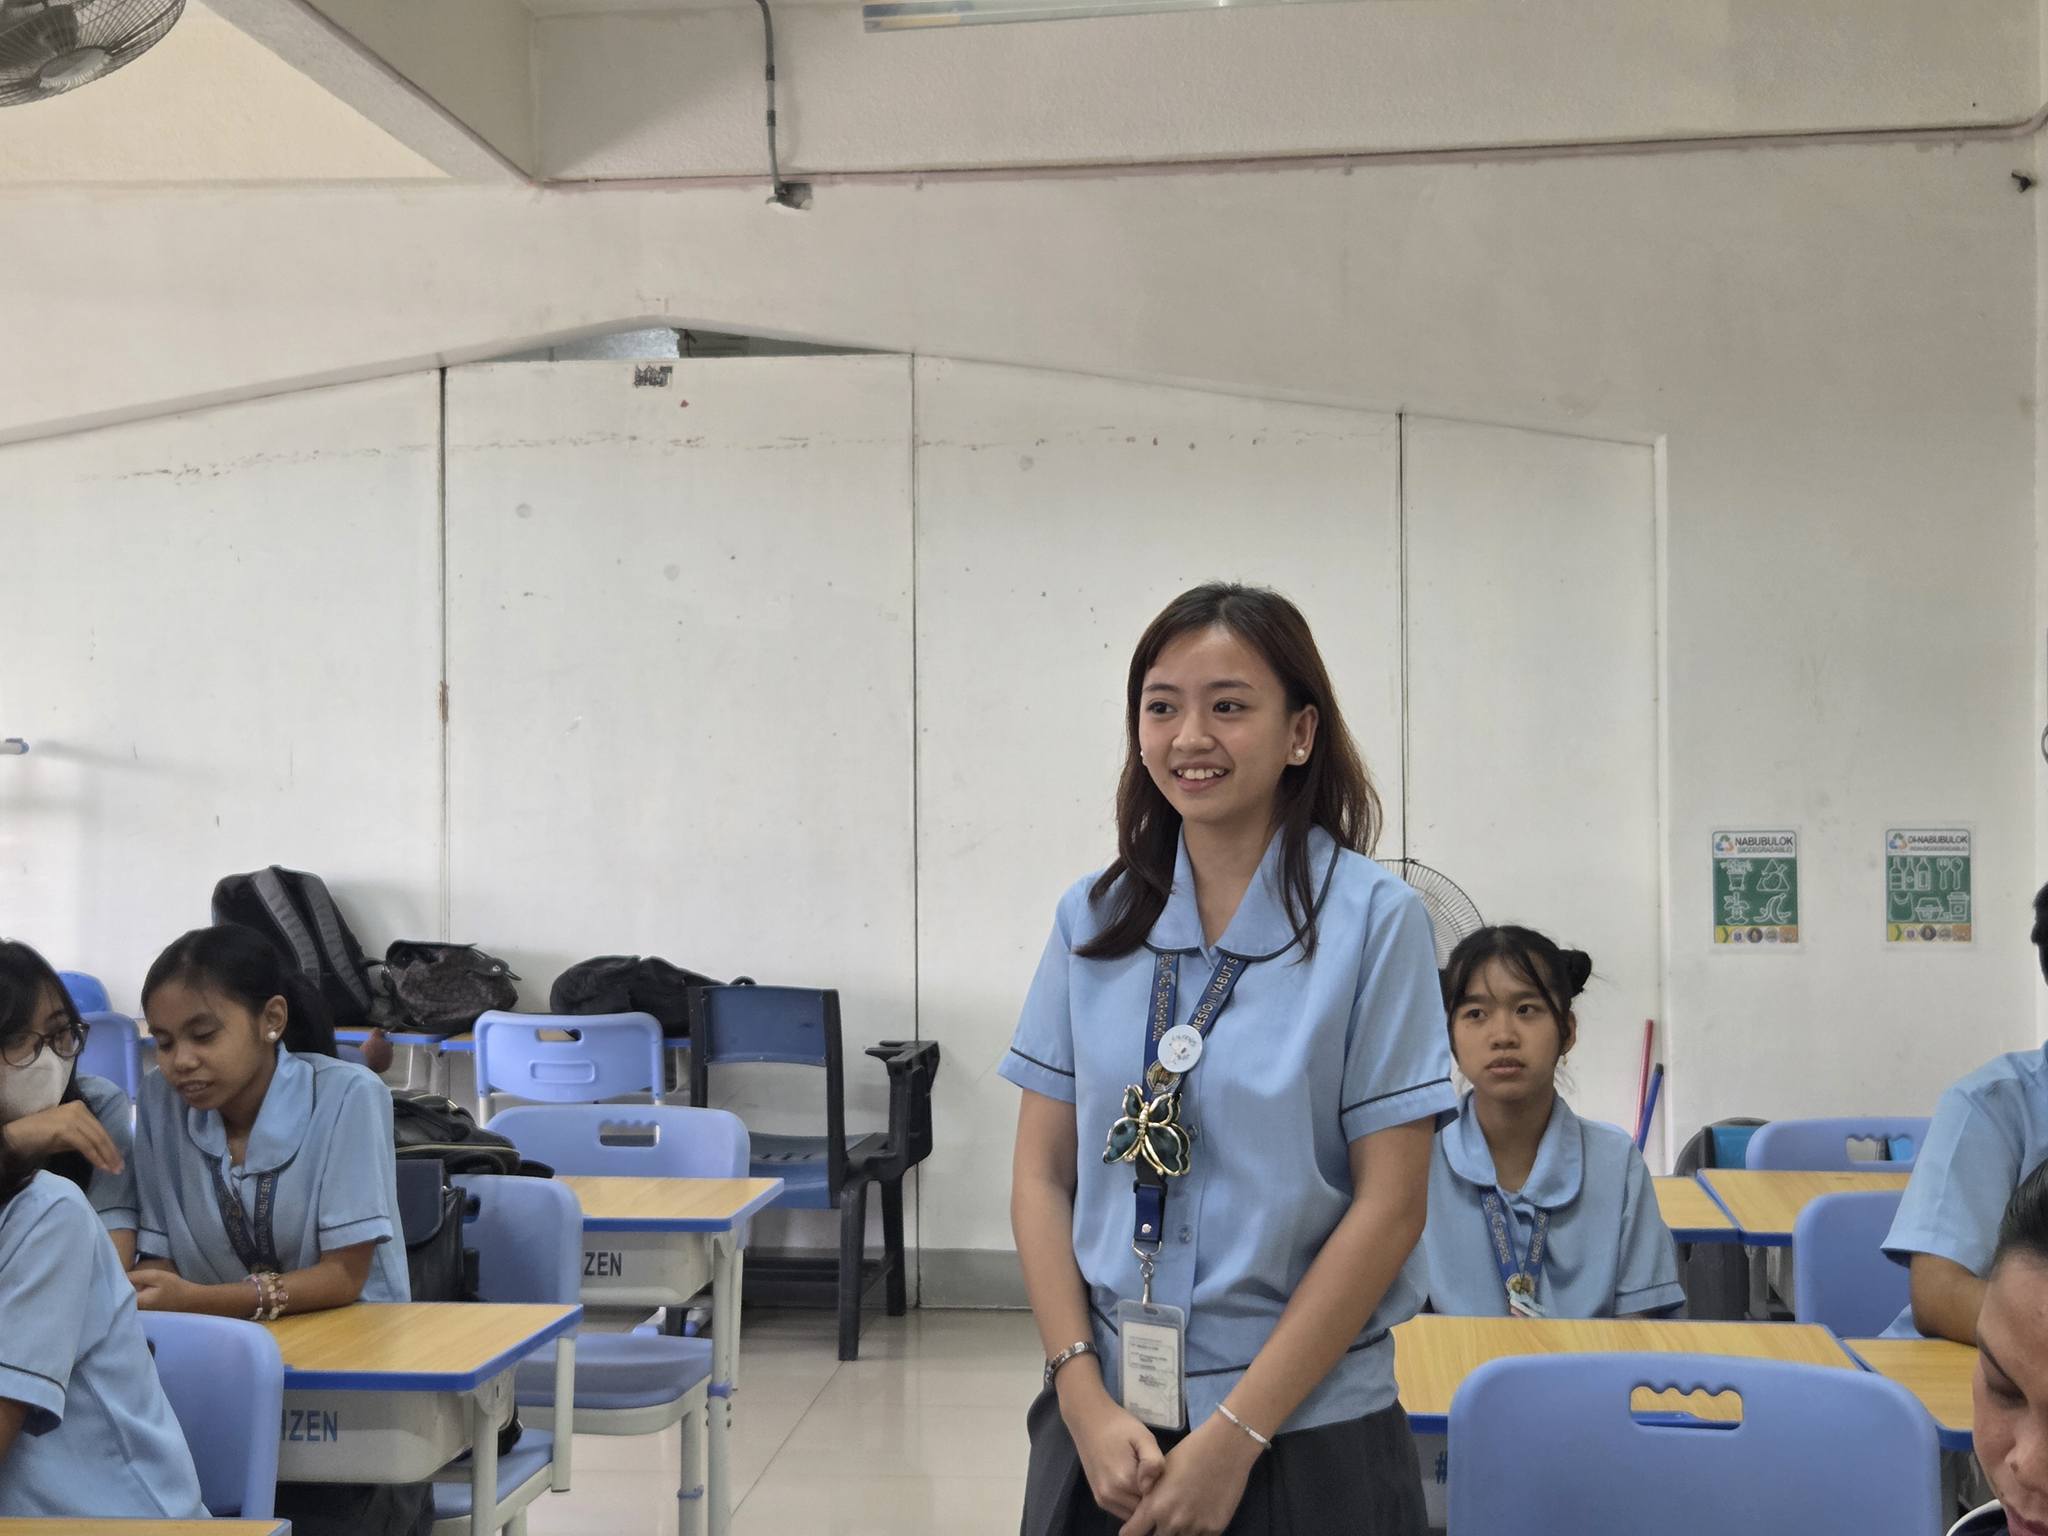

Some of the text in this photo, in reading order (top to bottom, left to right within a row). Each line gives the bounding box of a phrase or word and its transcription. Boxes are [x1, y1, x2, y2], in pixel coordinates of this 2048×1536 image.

[1735, 835, 1793, 848] NABUBULOK
[1210, 964, 1235, 994] YABUT
[584, 1251, 622, 1277] ZEN
